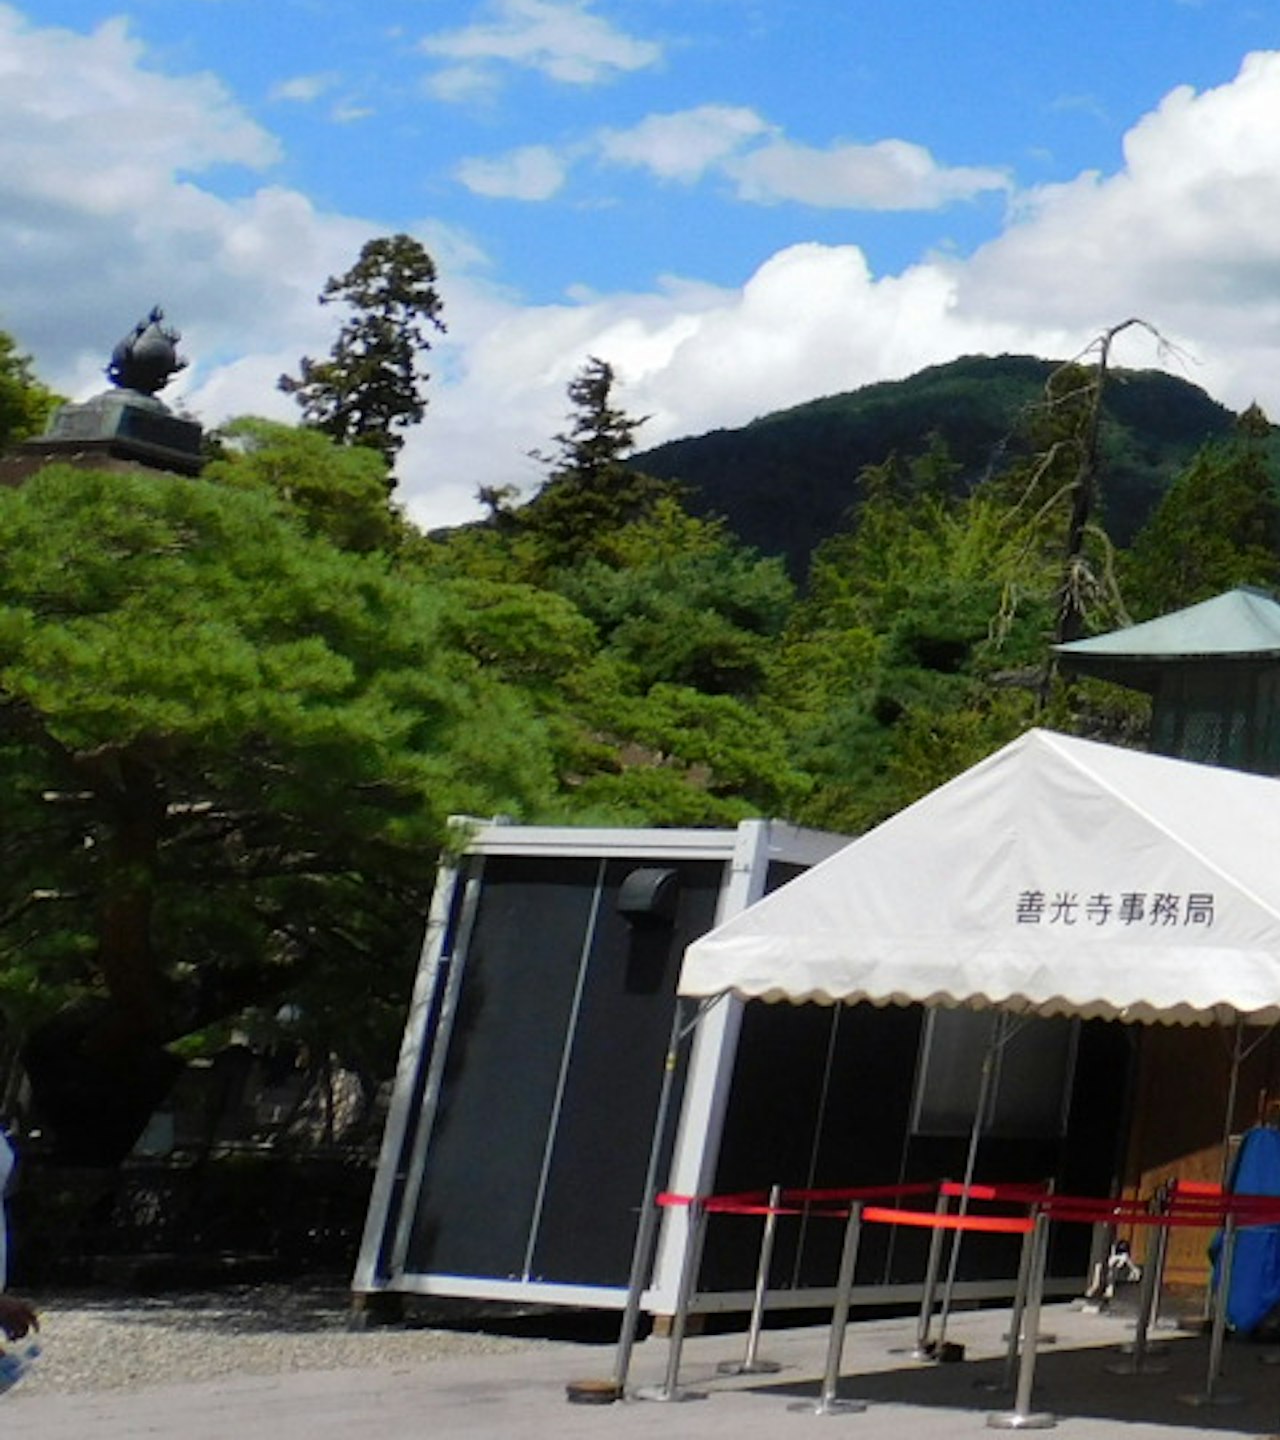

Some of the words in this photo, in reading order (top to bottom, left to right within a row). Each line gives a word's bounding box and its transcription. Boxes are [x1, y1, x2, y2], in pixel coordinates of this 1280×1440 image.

[1016, 889, 1215, 928] 善光寺事務局
